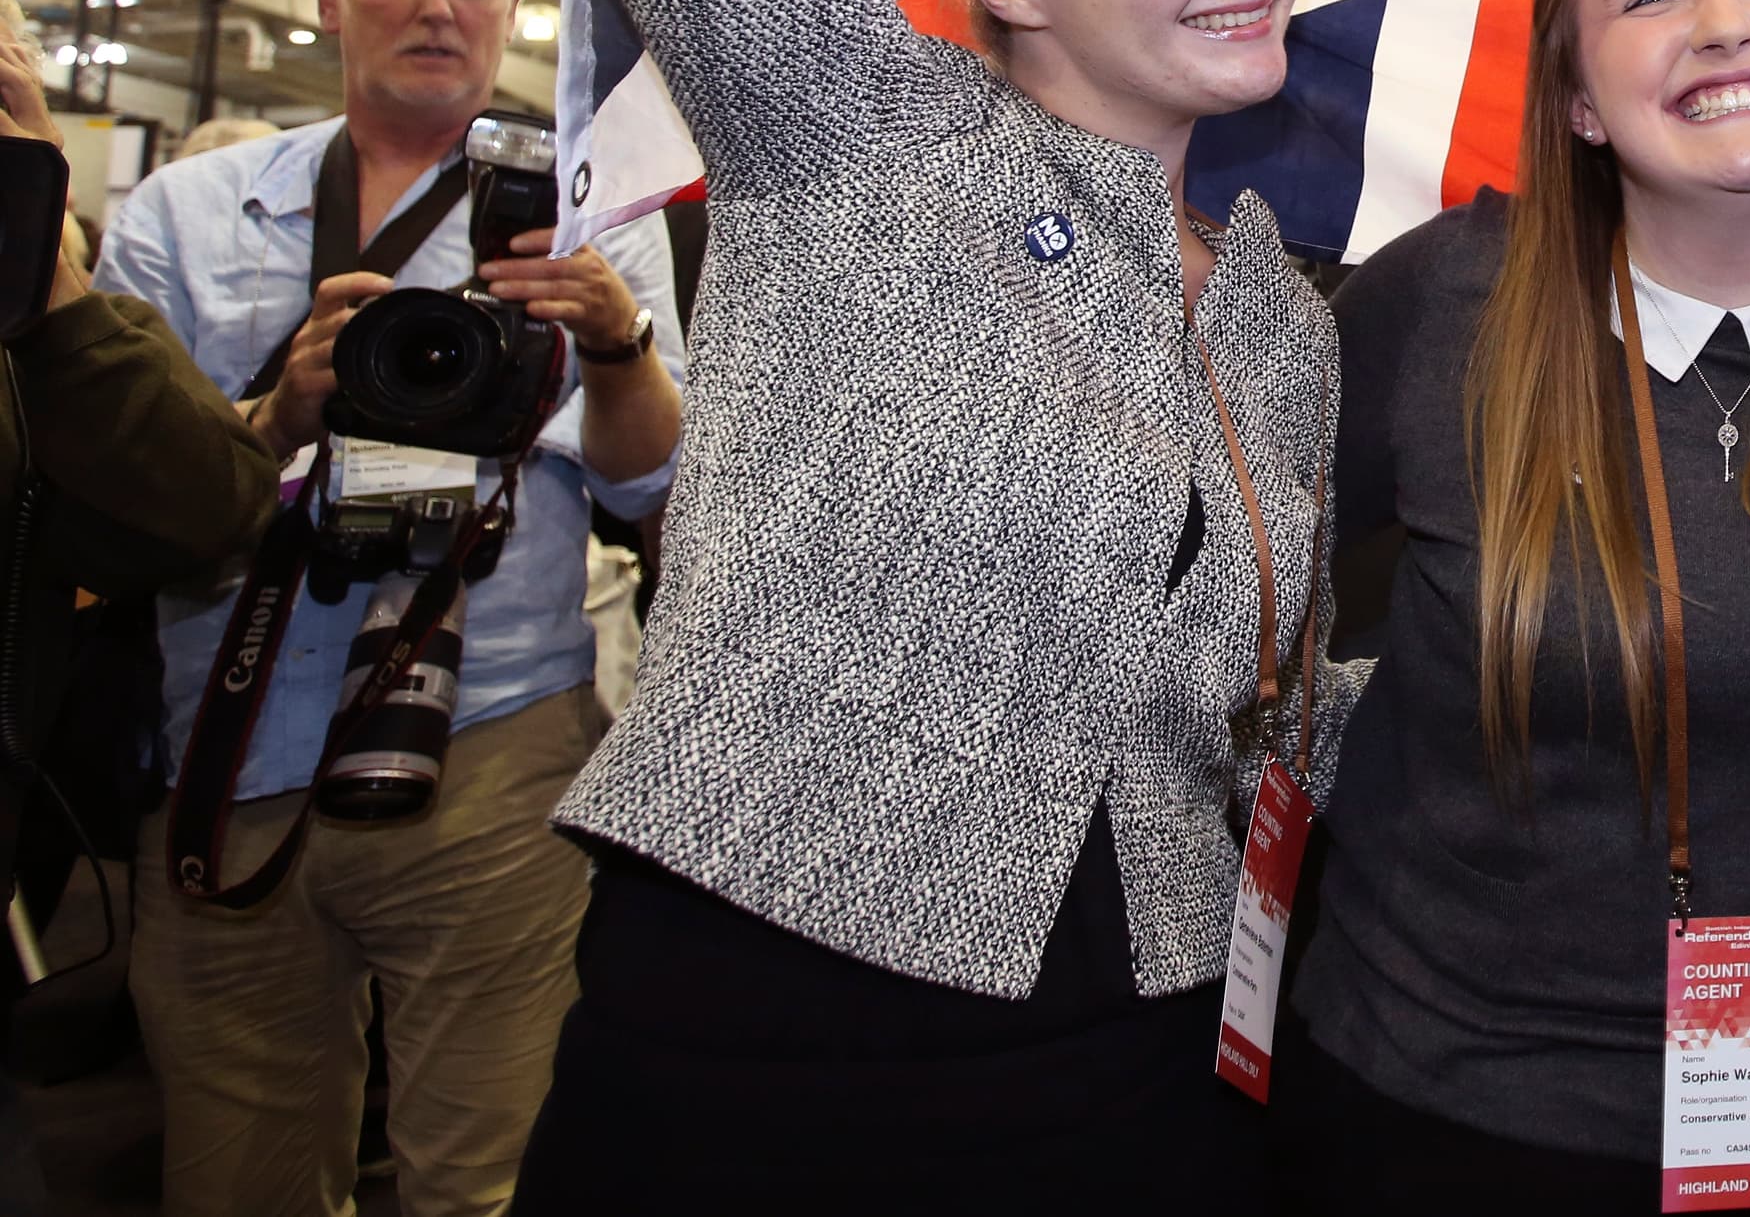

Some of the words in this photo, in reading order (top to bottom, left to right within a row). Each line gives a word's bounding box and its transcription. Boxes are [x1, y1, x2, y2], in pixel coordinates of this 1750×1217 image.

[225, 586, 280, 693] Canon
[1253, 826, 1272, 853] AGENT
[1683, 983, 1743, 1000] AGENT
[1681, 1055, 1706, 1063] Name
[1681, 1069, 1730, 1086] Sophie
[1680, 1094, 1748, 1105] Role/organisation
[1680, 1111, 1746, 1124] Conservative
[1680, 1148, 1699, 1156] Pass
[1679, 1178, 1749, 1195] HIGHLAND
